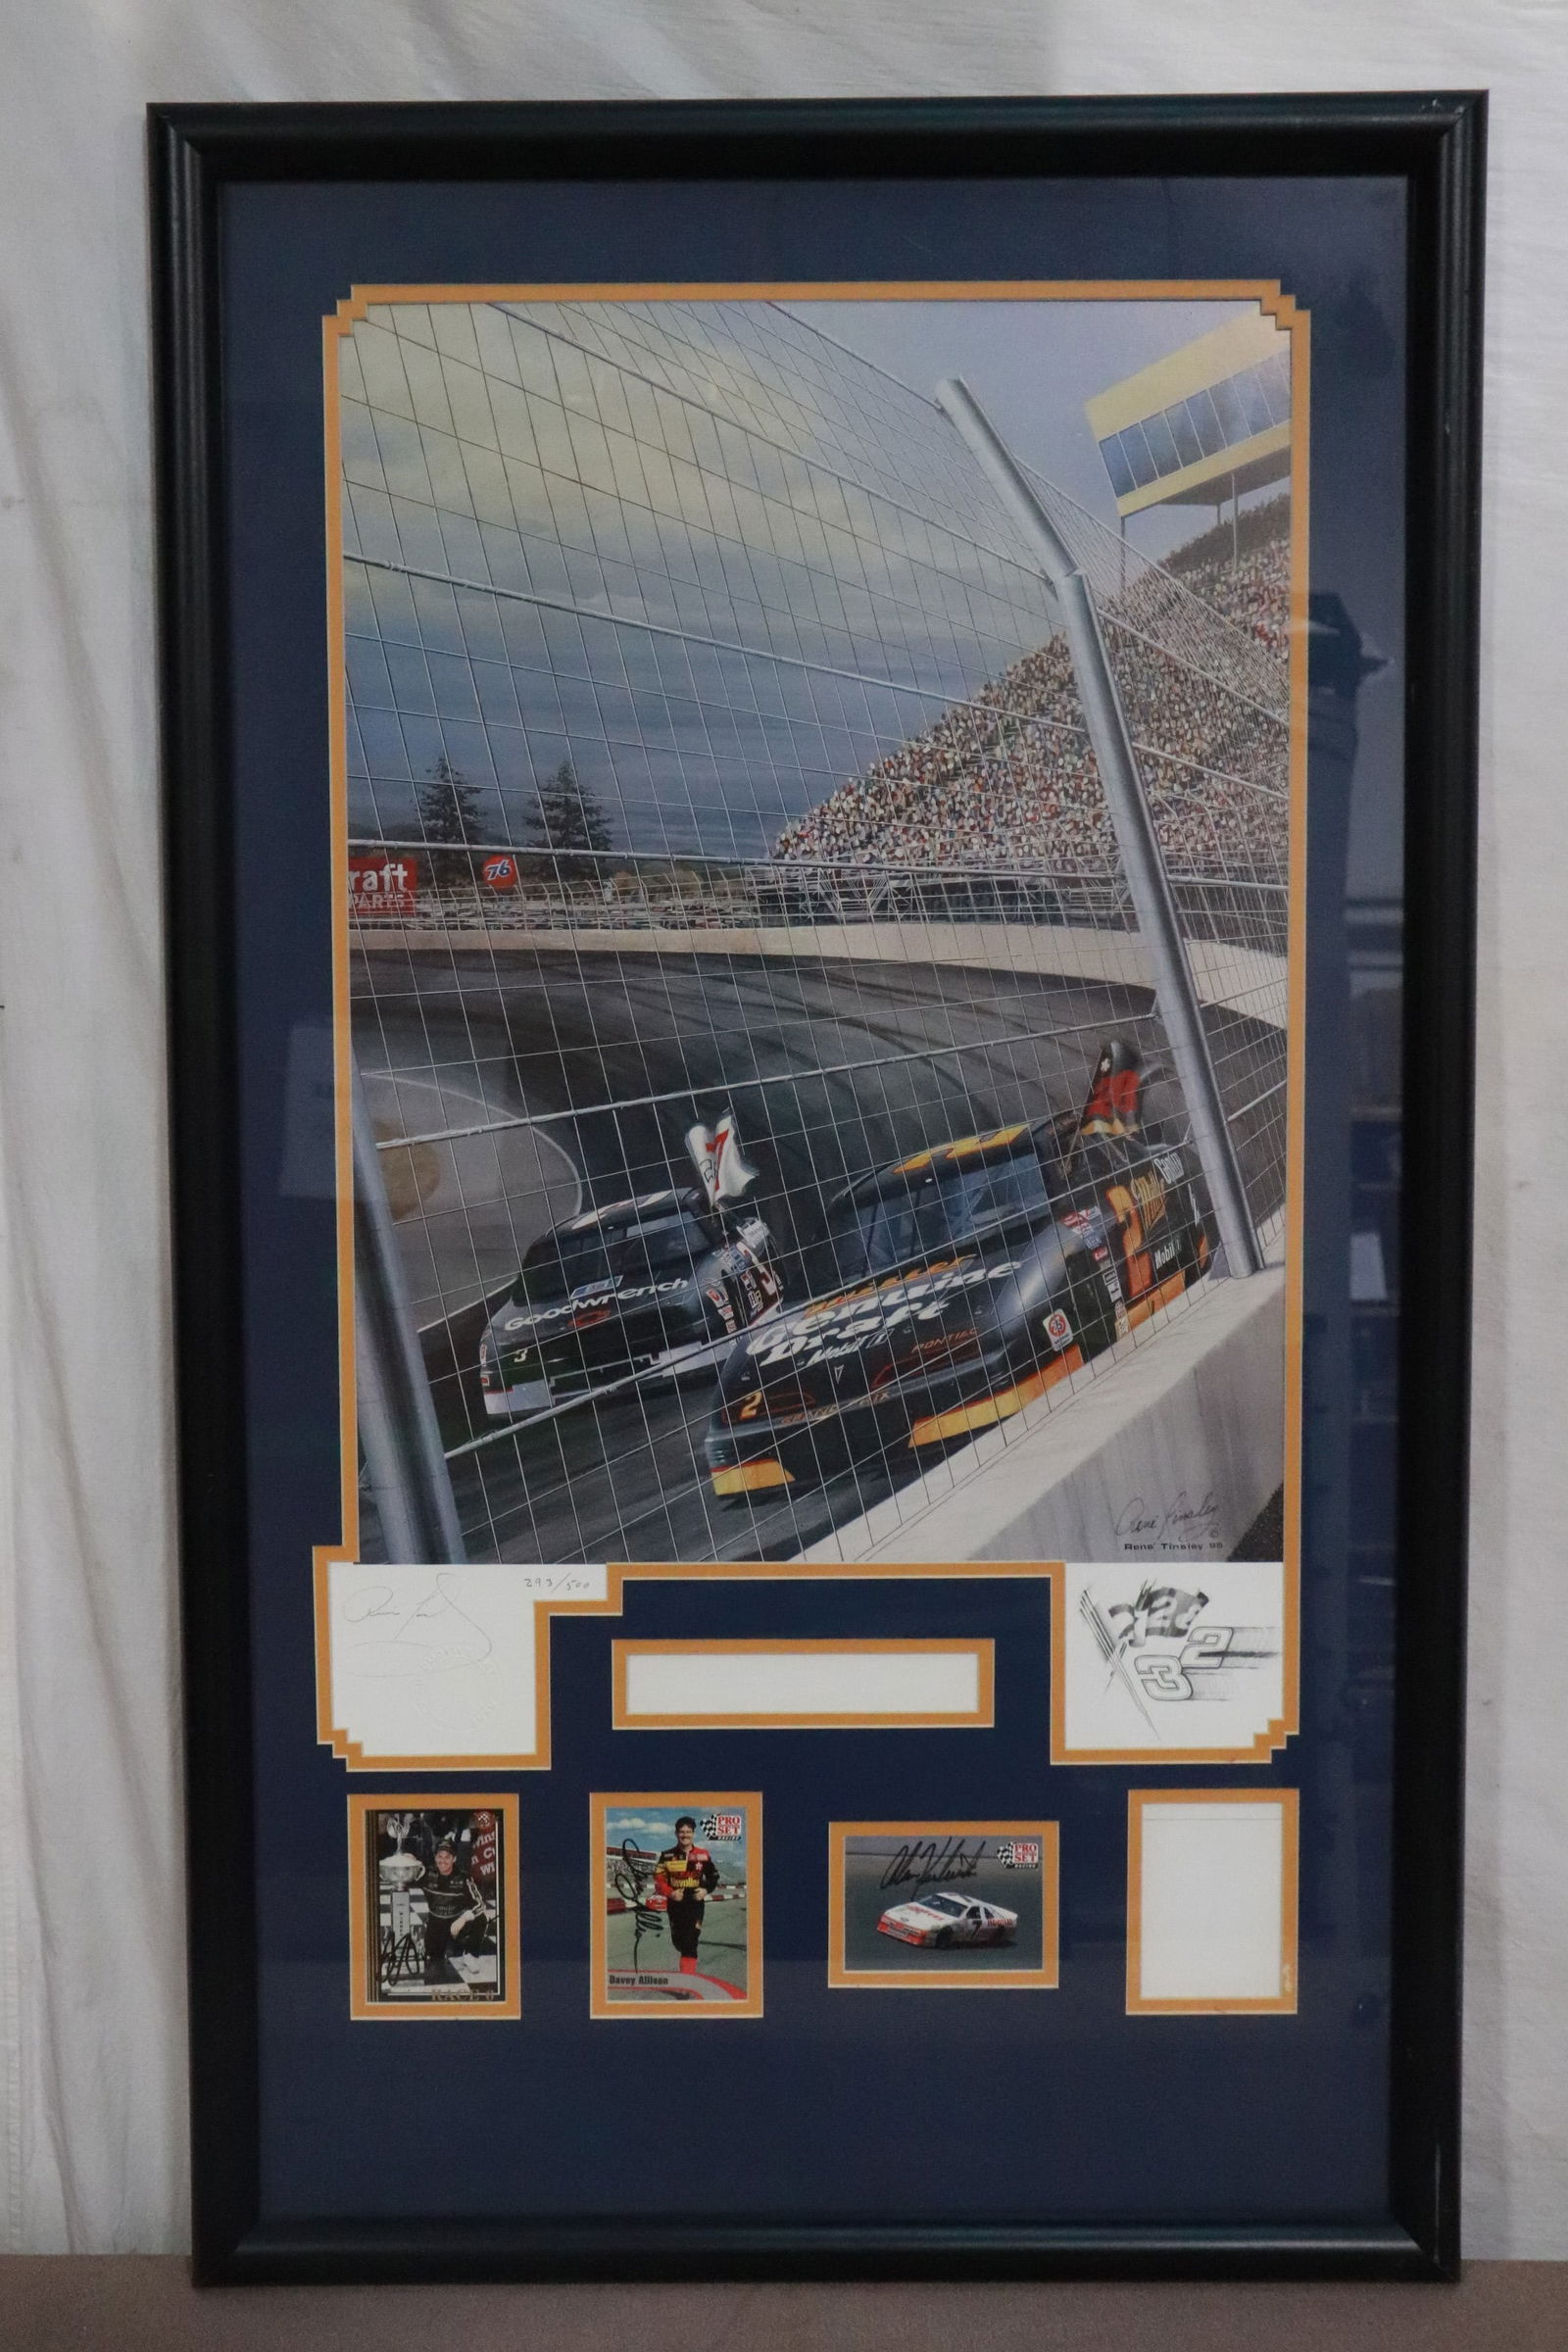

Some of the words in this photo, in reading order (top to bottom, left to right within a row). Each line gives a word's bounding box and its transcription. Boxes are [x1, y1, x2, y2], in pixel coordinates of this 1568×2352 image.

[486, 860, 511, 880] 76
[1154, 1241, 1177, 1269] Mobil
[505, 1278, 689, 1331] Goodwrench
[746, 1261, 1022, 1355] Genuine
[760, 1301, 949, 1367] Draft
[910, 1326, 980, 1353] PONTIAC
[514, 1348, 528, 1363] 3
[740, 1391, 762, 1420] 2
[1160, 1543, 1203, 1551] Tinsley
[717, 1816, 741, 1825] PRO
[717, 1826, 739, 1835] SET
[1014, 1843, 1037, 1852] PRO
[1014, 1853, 1036, 1862] SET
[970, 1919, 983, 1939] 7
[610, 1975, 636, 1985] Davey
[638, 1975, 668, 1984] Allison
